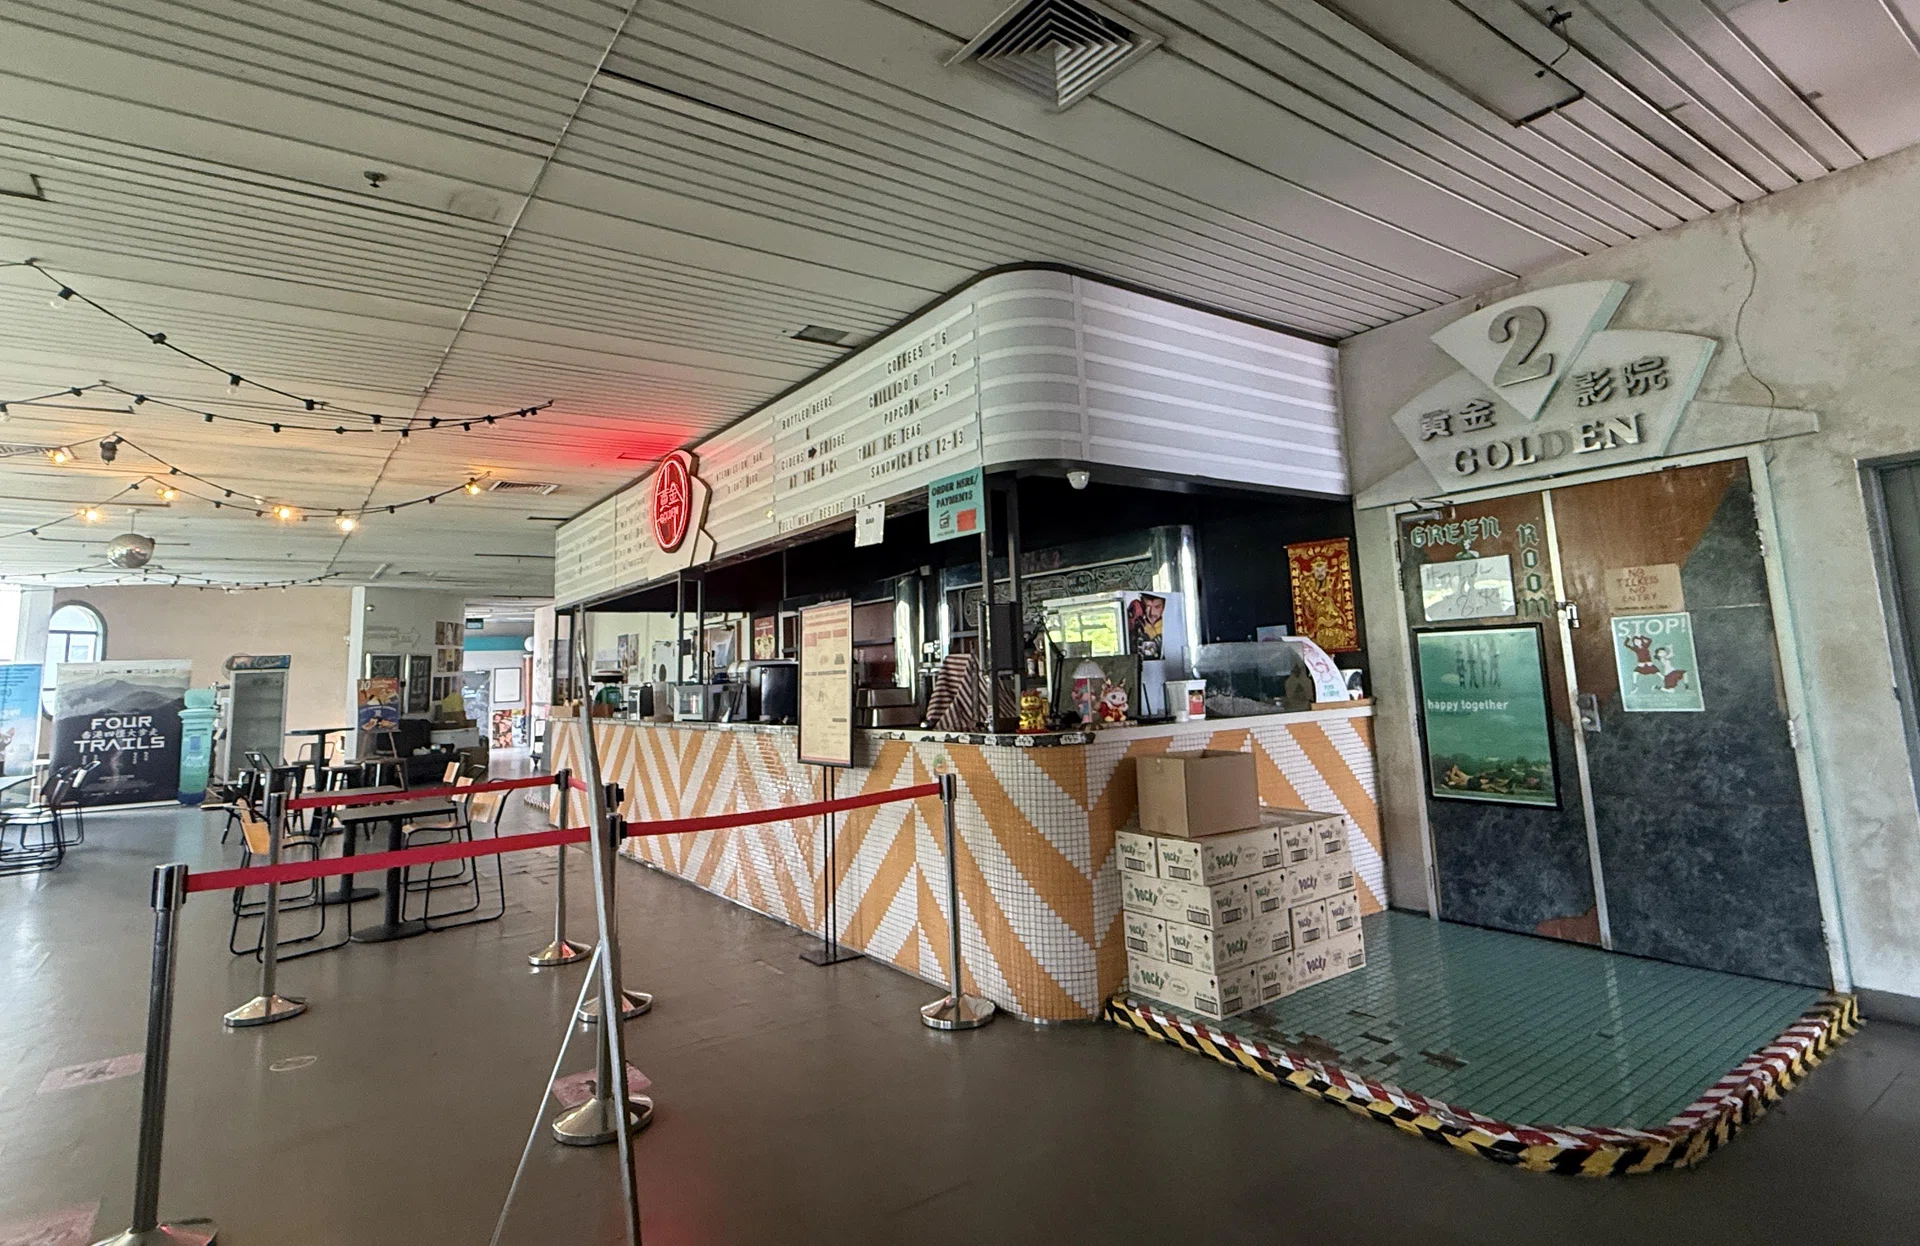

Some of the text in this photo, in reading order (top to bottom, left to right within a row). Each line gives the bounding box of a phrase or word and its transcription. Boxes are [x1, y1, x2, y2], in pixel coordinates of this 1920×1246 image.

[1488, 305, 1553, 387] 2
[782, 395, 832, 430] BOTTLED BEERS
[884, 398, 919, 425] POPCORN
[936, 430, 964, 455] 12-13
[1455, 413, 1645, 476] GOLDEN
[931, 482, 955, 497] ORDER
[936, 490, 974, 509] PAYMENTS
[852, 493, 866, 509] BAR
[1410, 516, 1502, 548] GREEN
[1617, 617, 1686, 637] STOP!
[1427, 698, 1509, 712] happy together
[91, 715, 153, 731] FOUR
[73, 735, 165, 754] TRAILS
